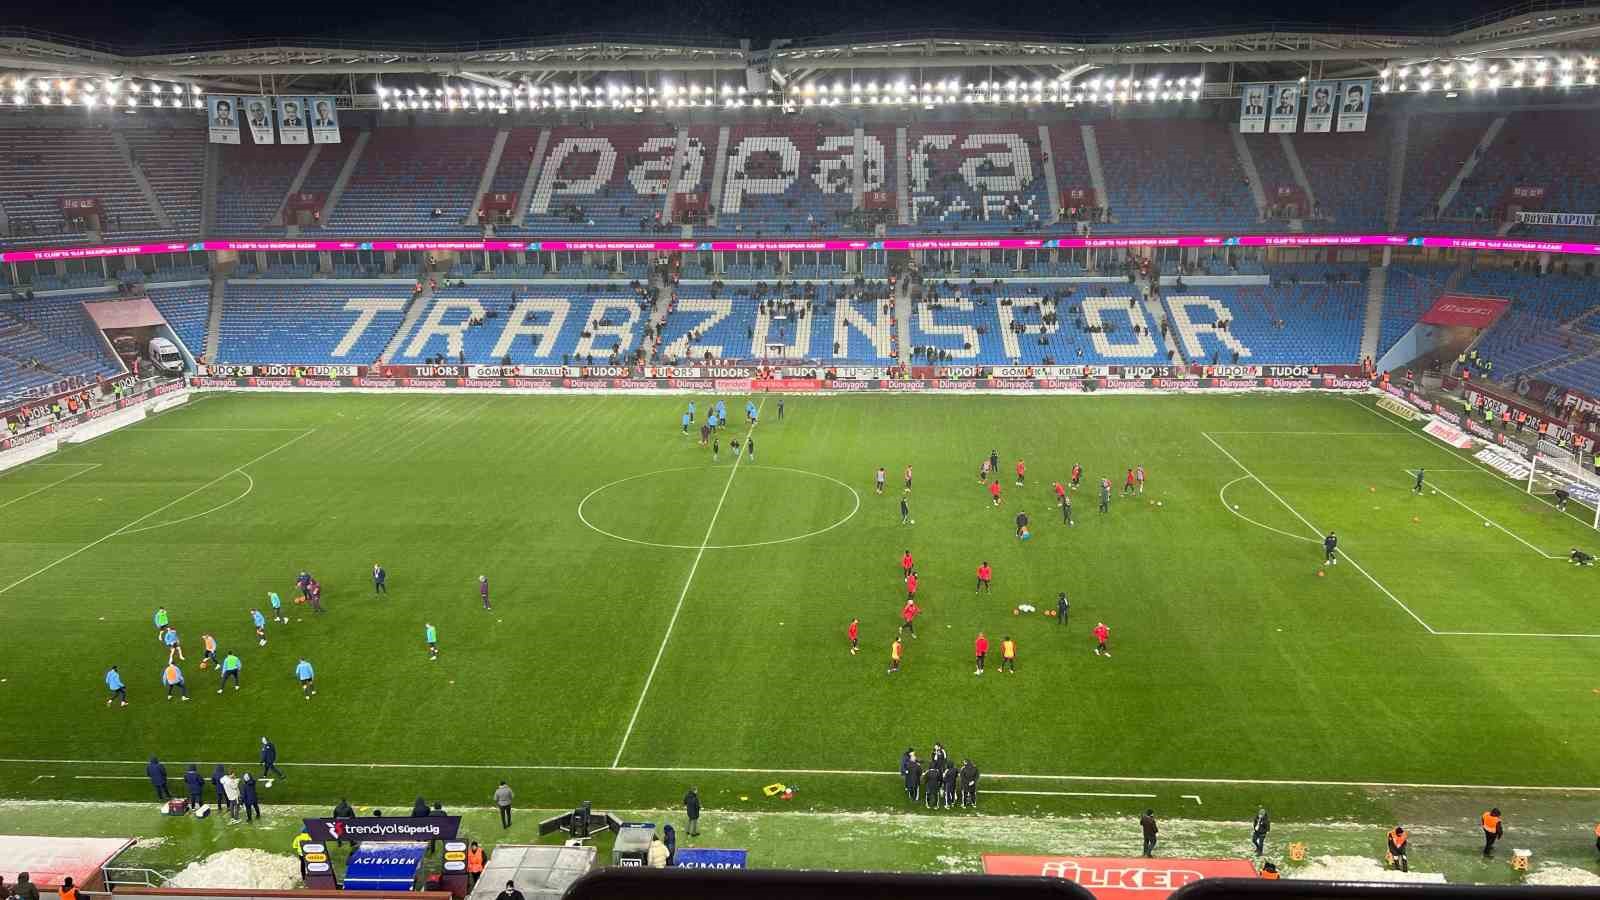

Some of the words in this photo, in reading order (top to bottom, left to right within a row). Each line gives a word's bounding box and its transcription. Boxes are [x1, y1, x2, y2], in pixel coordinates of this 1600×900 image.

[529, 134, 1034, 214] papara
[331, 296, 1252, 359] TRABZONSPOR
[708, 367, 750, 378] TUDORS
[1124, 366, 1169, 376] TUDOS
[1270, 366, 1311, 376] TUDOR
[345, 823, 398, 836] trendyol
[354, 857, 416, 866] ACIBADEM
